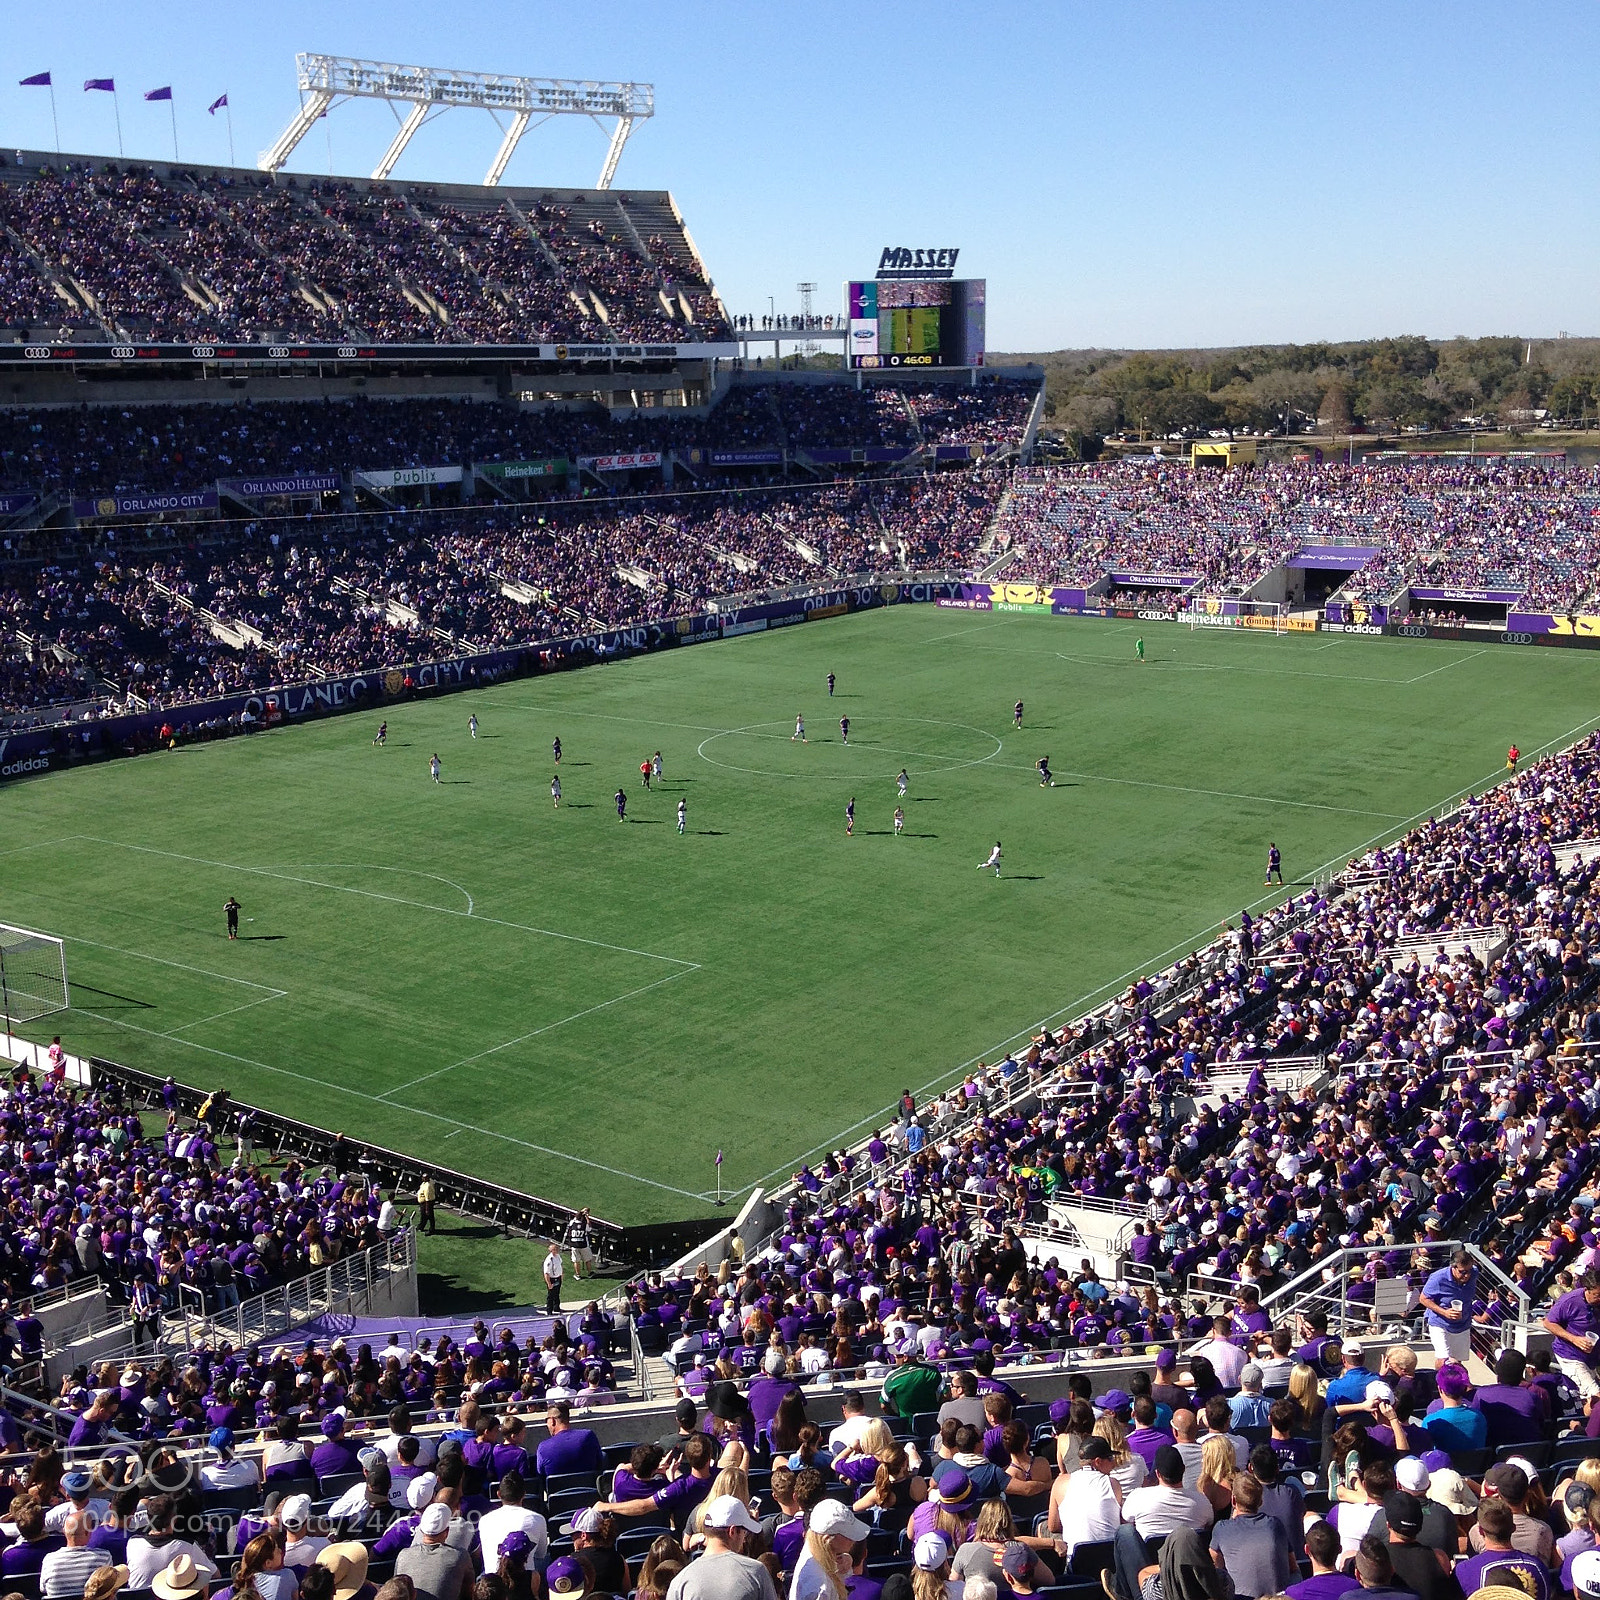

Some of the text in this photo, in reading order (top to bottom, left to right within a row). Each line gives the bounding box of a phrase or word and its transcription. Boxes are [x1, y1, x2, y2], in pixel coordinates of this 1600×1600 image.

[878, 247, 960, 268] MASSEY
[393, 471, 437, 485] Publix
[504, 464, 545, 477] Heineken
[242, 477, 337, 495] ORLANDO HEALTH
[122, 495, 205, 511] ORLANDO CITY
[911, 583, 960, 602] CITY
[998, 603, 1023, 611] Publix
[1177, 612, 1231, 626] Heineken
[1345, 624, 1382, 634] adidas
[2, 758, 49, 775] adidas
